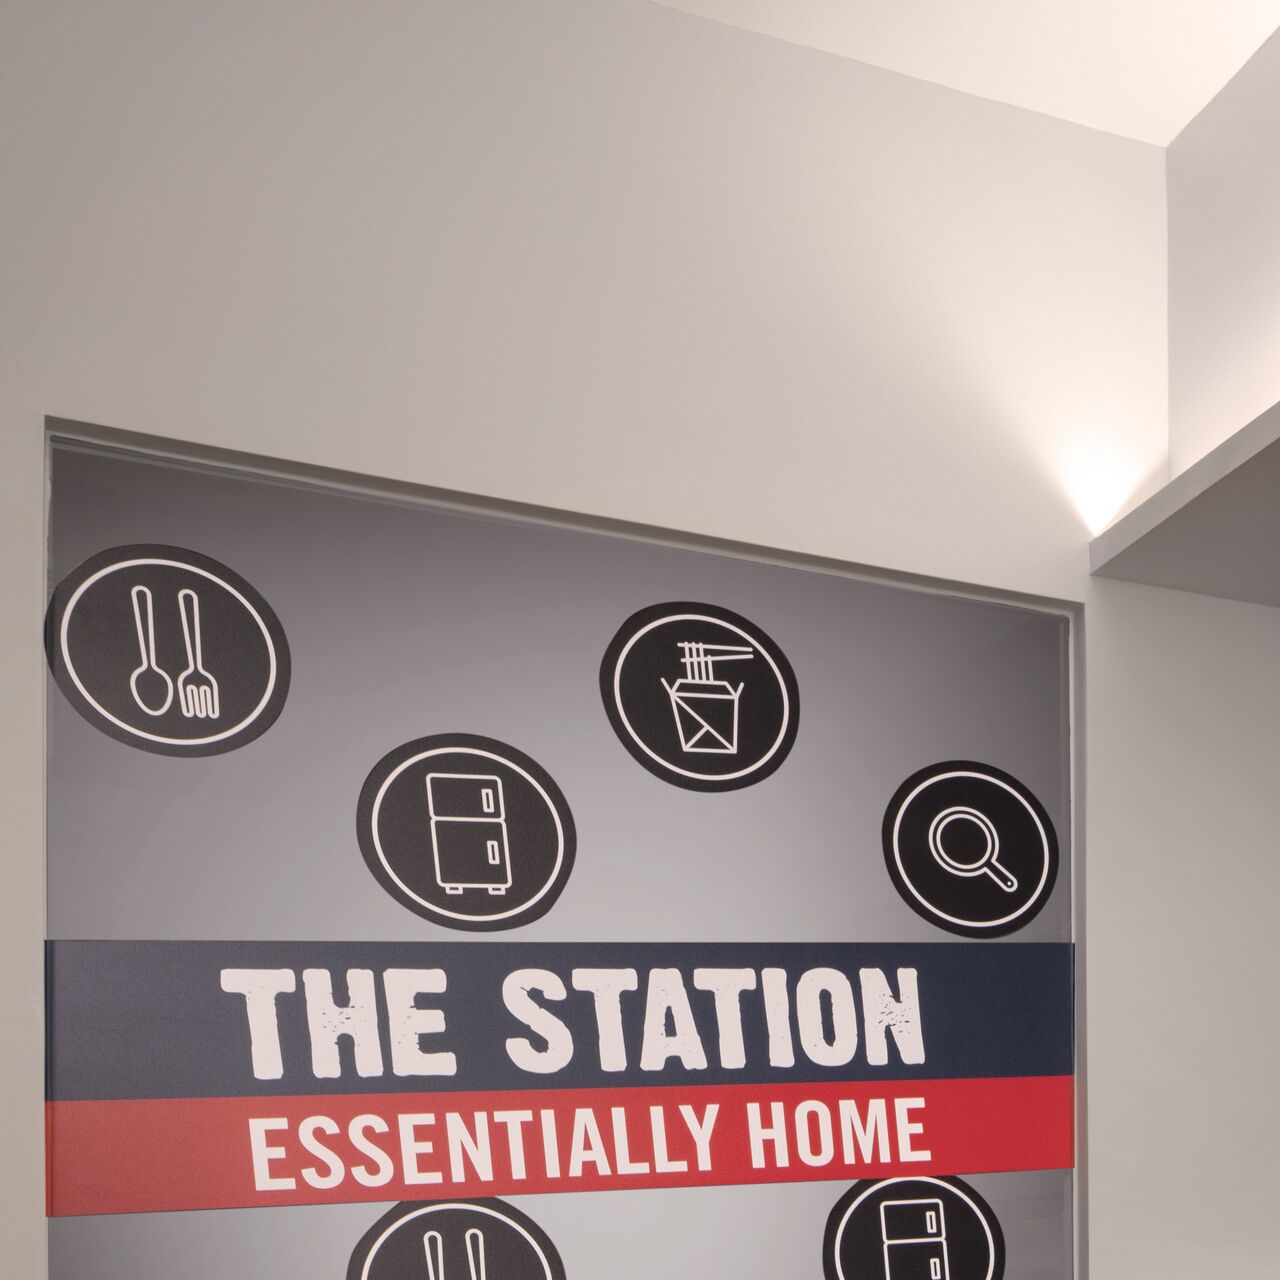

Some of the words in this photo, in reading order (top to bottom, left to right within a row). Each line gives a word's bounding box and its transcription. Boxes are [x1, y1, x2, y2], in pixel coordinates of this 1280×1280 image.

[220, 967, 457, 1081] THE
[501, 966, 926, 1076] STATION
[247, 1103, 720, 1193] ESSENTIALLY
[748, 1096, 932, 1167] HOME
